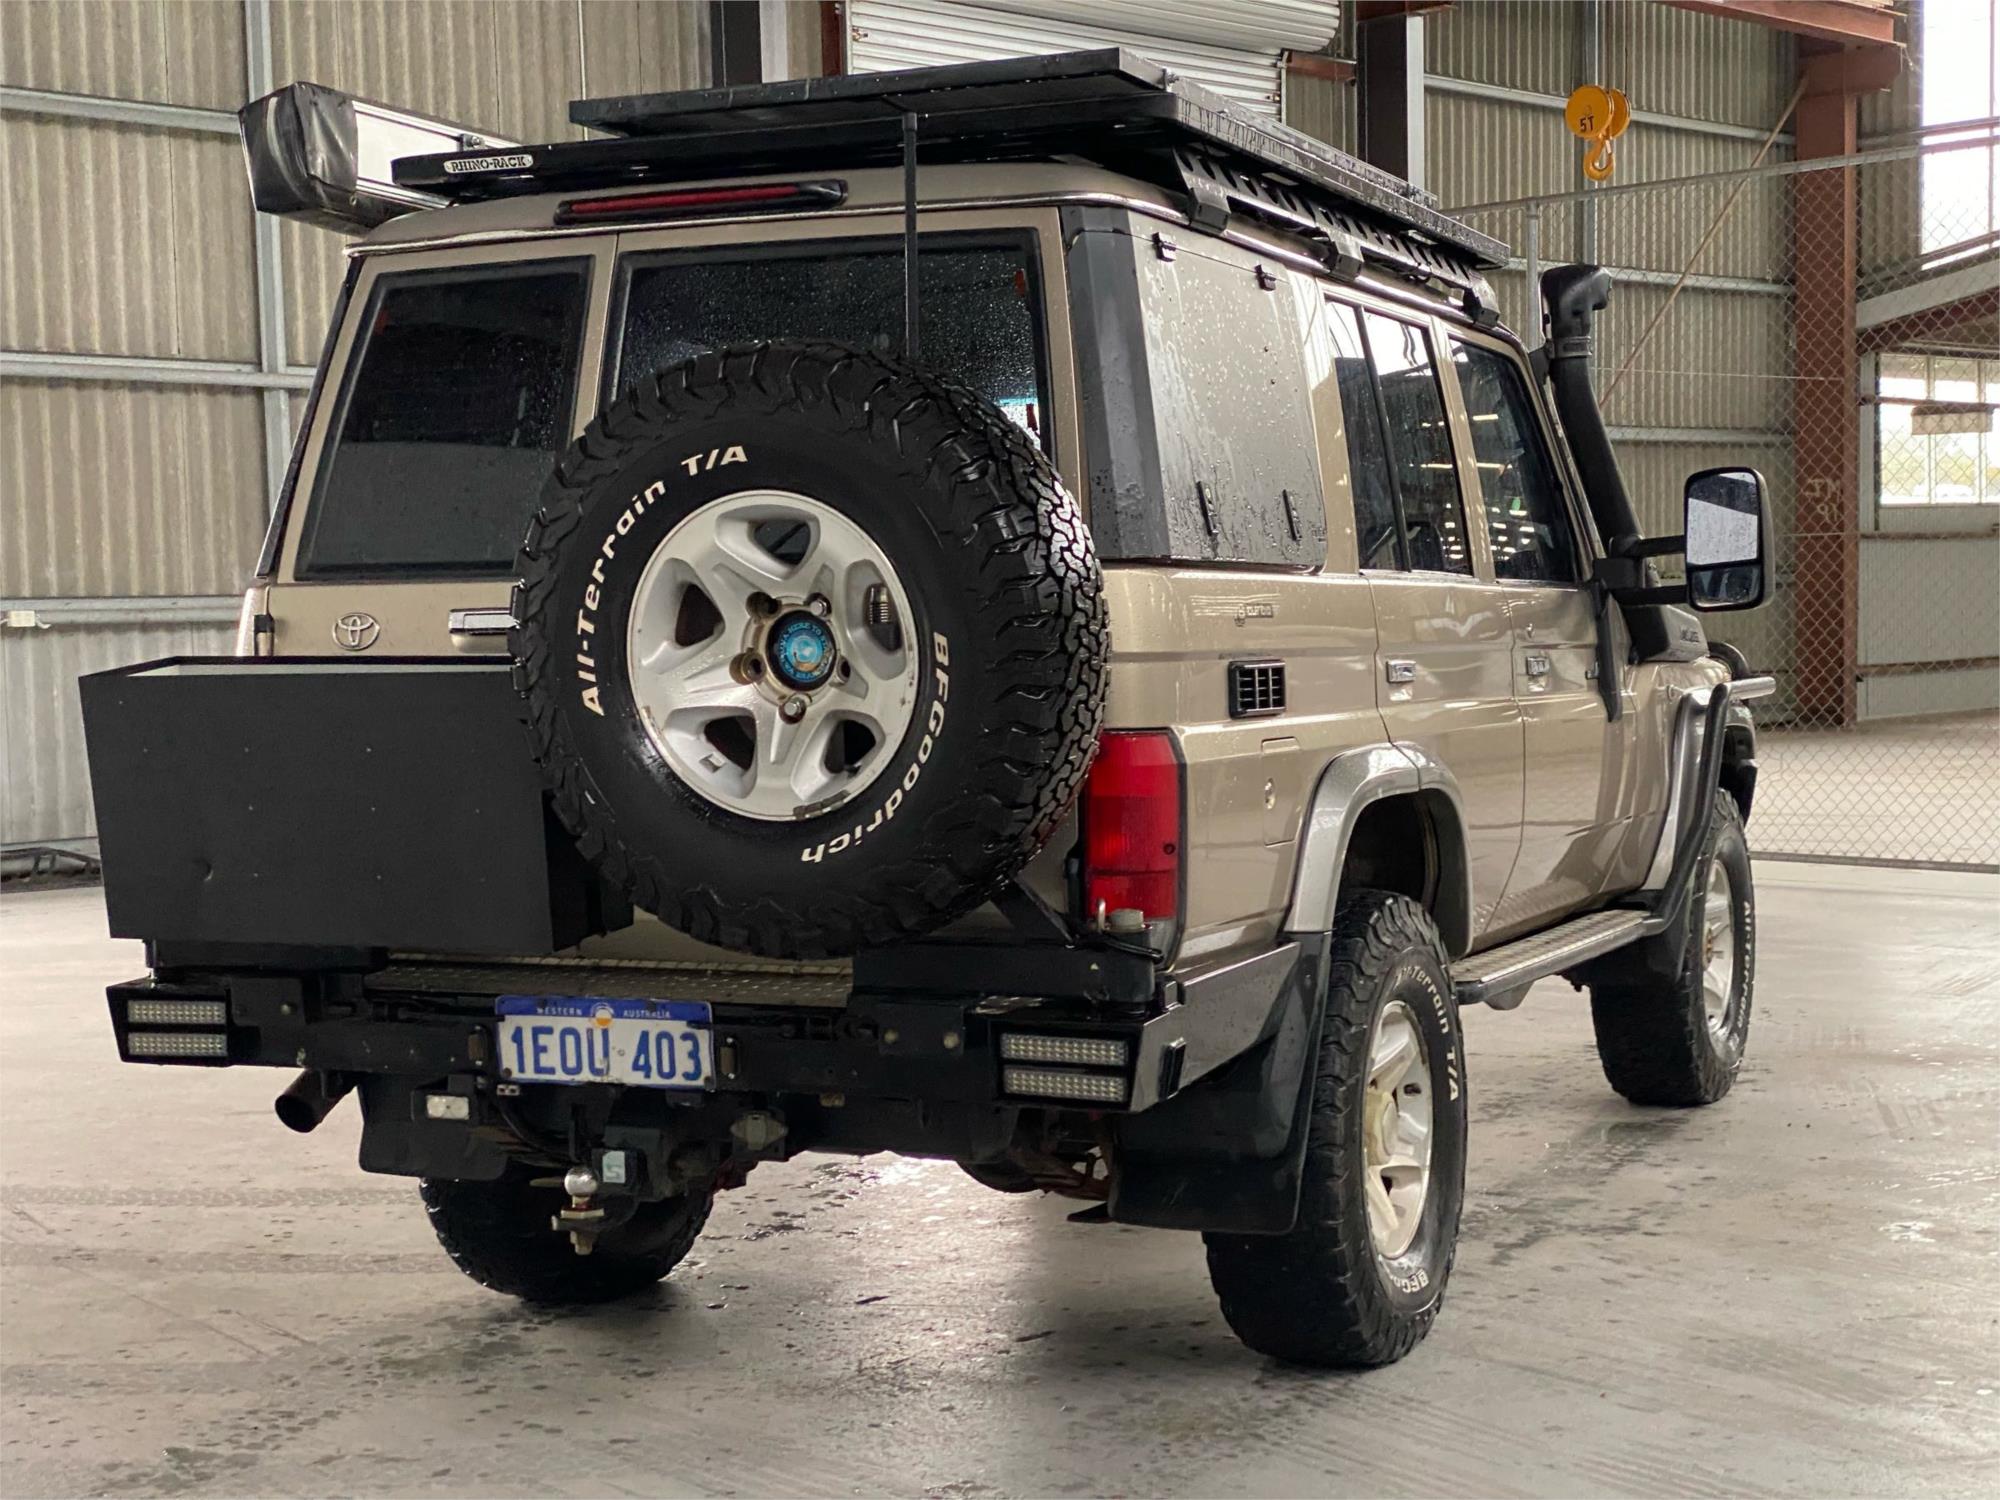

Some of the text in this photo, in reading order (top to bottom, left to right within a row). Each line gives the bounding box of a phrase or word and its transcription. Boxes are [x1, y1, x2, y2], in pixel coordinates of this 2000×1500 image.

[450, 156, 526, 172] RHINO-RACK
[577, 446, 748, 716] All-Terrain T/A
[801, 632, 949, 863] BFGoodrich
[536, 1006, 671, 1019] WESTERN AUSTRALIA
[632, 1030, 702, 1081] 403
[1446, 1046, 1459, 1101] T/A
